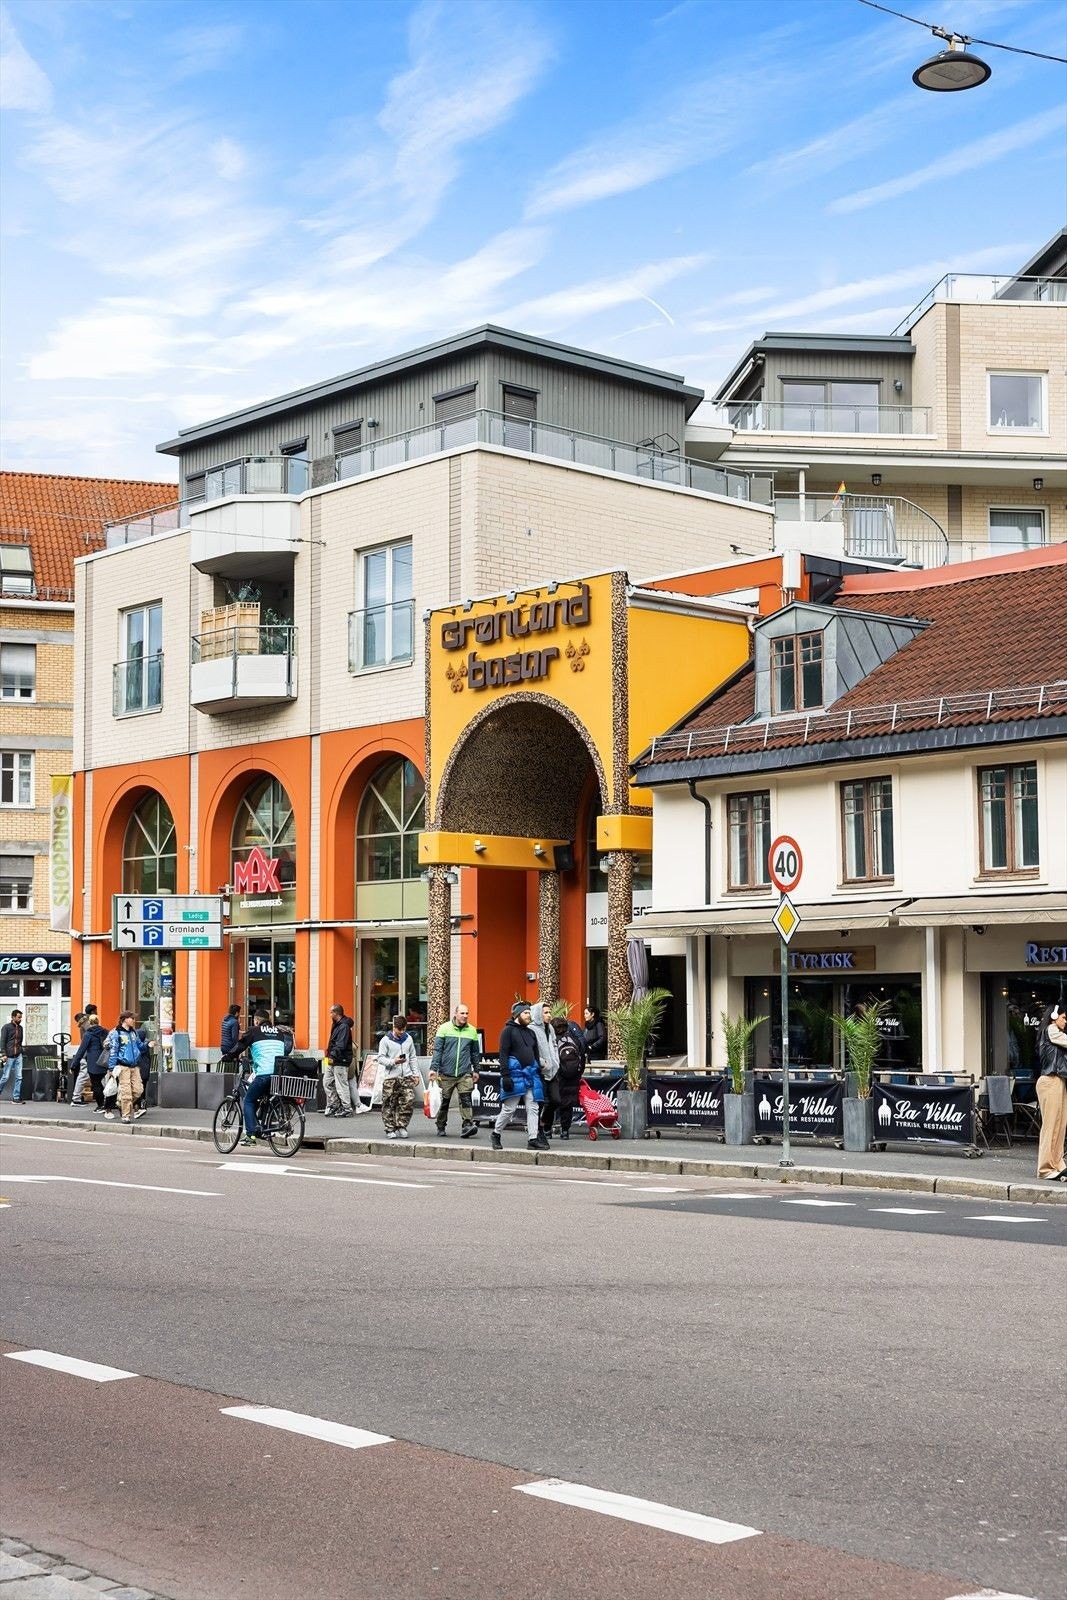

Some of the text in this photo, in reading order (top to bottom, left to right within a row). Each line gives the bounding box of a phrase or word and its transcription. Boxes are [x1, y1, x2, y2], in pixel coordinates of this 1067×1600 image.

[468, 647, 560, 689] basar
[52, 805, 69, 907] SHOPPING
[775, 850, 797, 878] 40
[234, 847, 279, 895] MAX
[149, 906, 159, 919] P
[590, 917, 608, 926] 10-20
[149, 931, 159, 945] P
[789, 952, 854, 970] TYRKISK
[260, 1025, 279, 1034] Wolt
[664, 1090, 720, 1109] La Villa
[799, 1096, 837, 1116] Villa
[893, 1100, 966, 1123] La Villa
[923, 1123, 963, 1131] RESTAURANT
